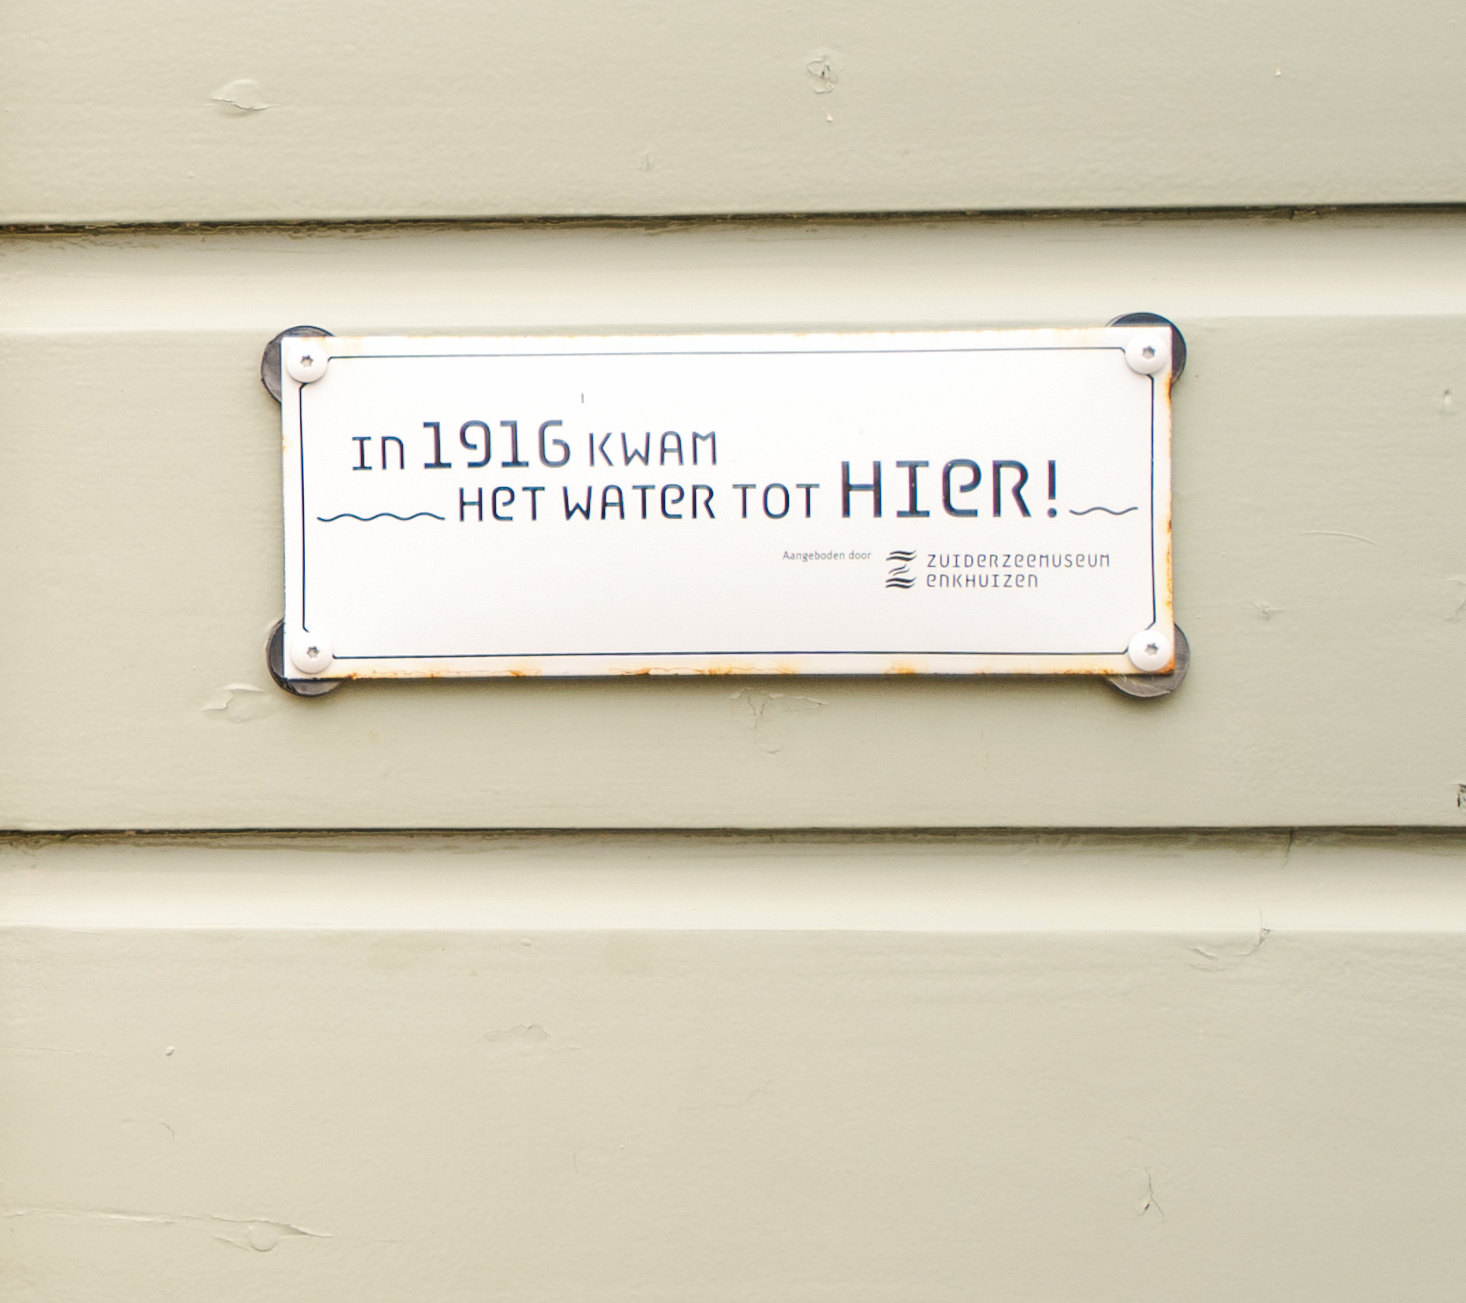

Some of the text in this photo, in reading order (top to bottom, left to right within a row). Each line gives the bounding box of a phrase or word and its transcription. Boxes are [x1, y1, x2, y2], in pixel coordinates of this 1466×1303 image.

[422, 419, 571, 469] 1916
[588, 430, 717, 467] KWAM
[731, 482, 820, 519] TOT
[782, 550, 872, 563] Aangeboden door
